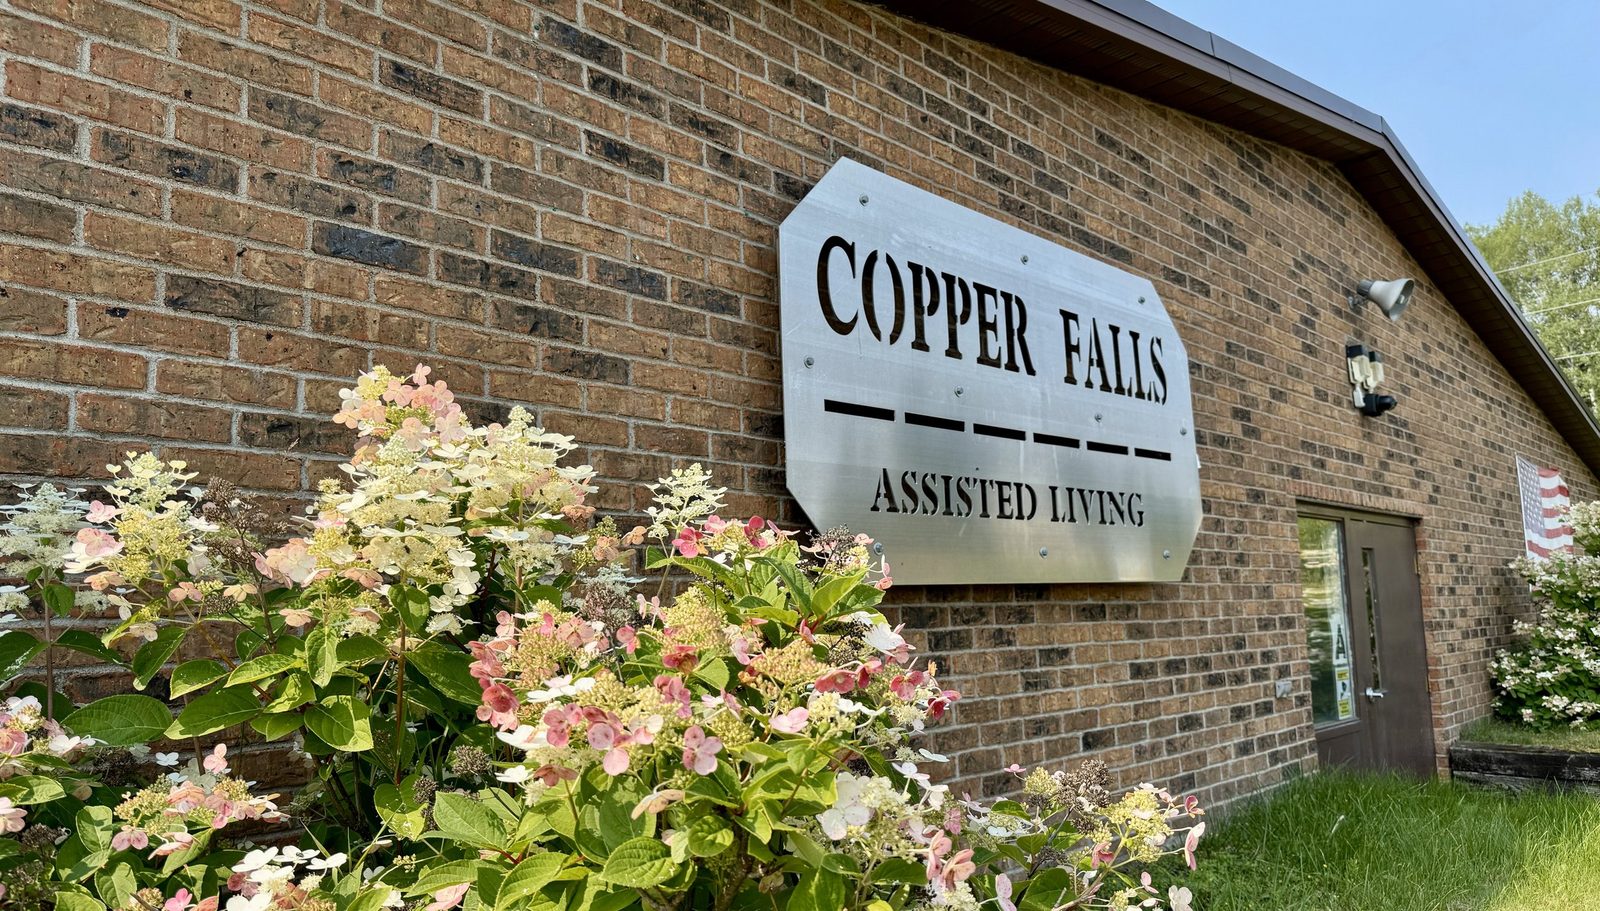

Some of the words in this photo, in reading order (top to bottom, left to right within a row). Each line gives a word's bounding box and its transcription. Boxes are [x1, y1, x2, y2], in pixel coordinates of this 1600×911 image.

[816, 235, 1037, 376] COPPER
[1059, 308, 1168, 406] FALLS
[870, 467, 1038, 522] ASSISTED
[1048, 484, 1145, 528] LIVING
